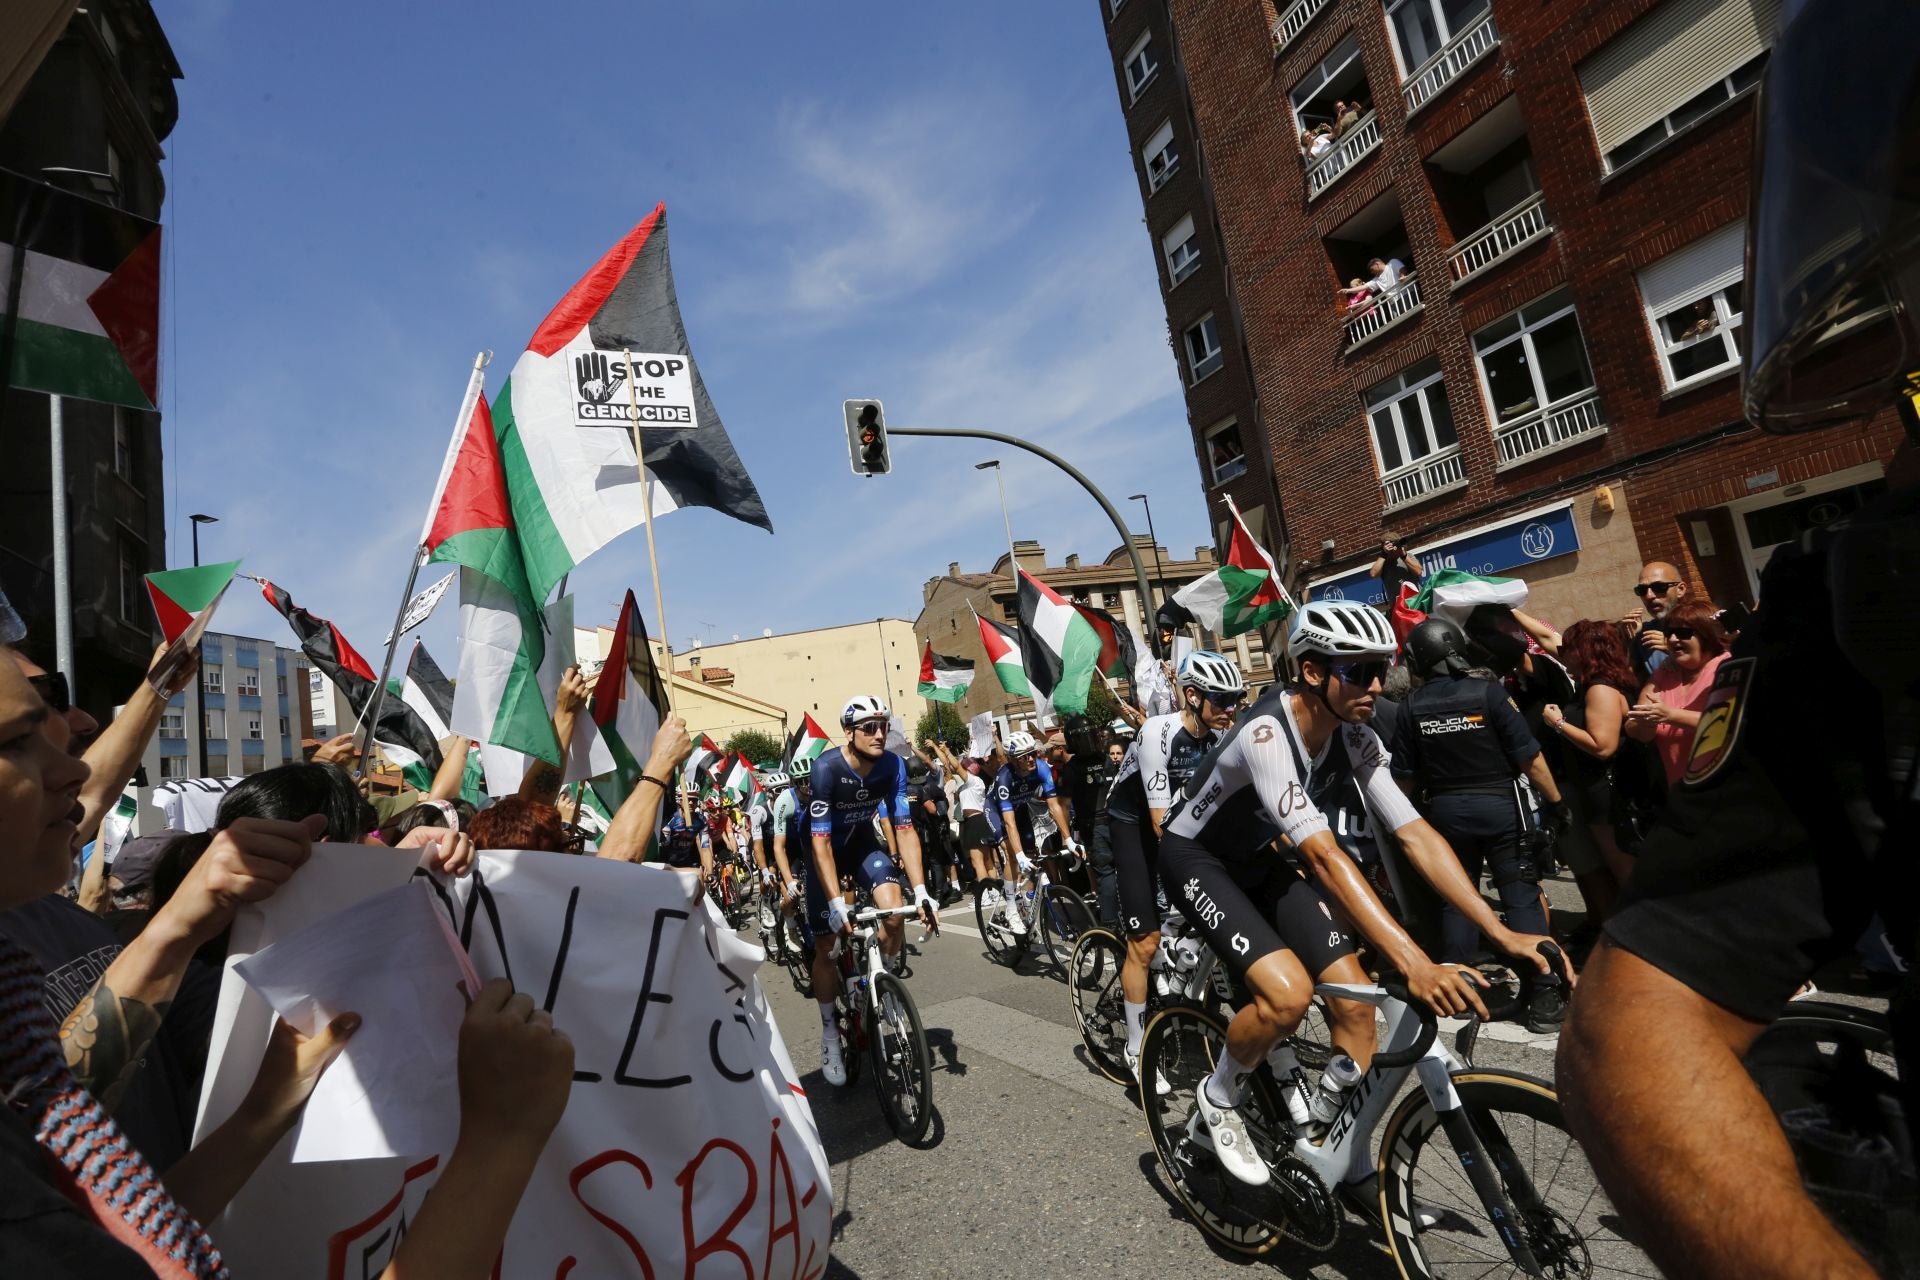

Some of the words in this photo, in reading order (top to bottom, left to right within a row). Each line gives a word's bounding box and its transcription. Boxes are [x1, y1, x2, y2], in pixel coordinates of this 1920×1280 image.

[610, 360, 684, 380] STOP
[580, 404, 690, 421] GENOCIDE
[1300, 628, 1332, 642] SCOTT
[1420, 716, 1470, 729] POLICIA
[1421, 722, 1486, 735] NACIONAL
[1195, 891, 1225, 930] UBS
